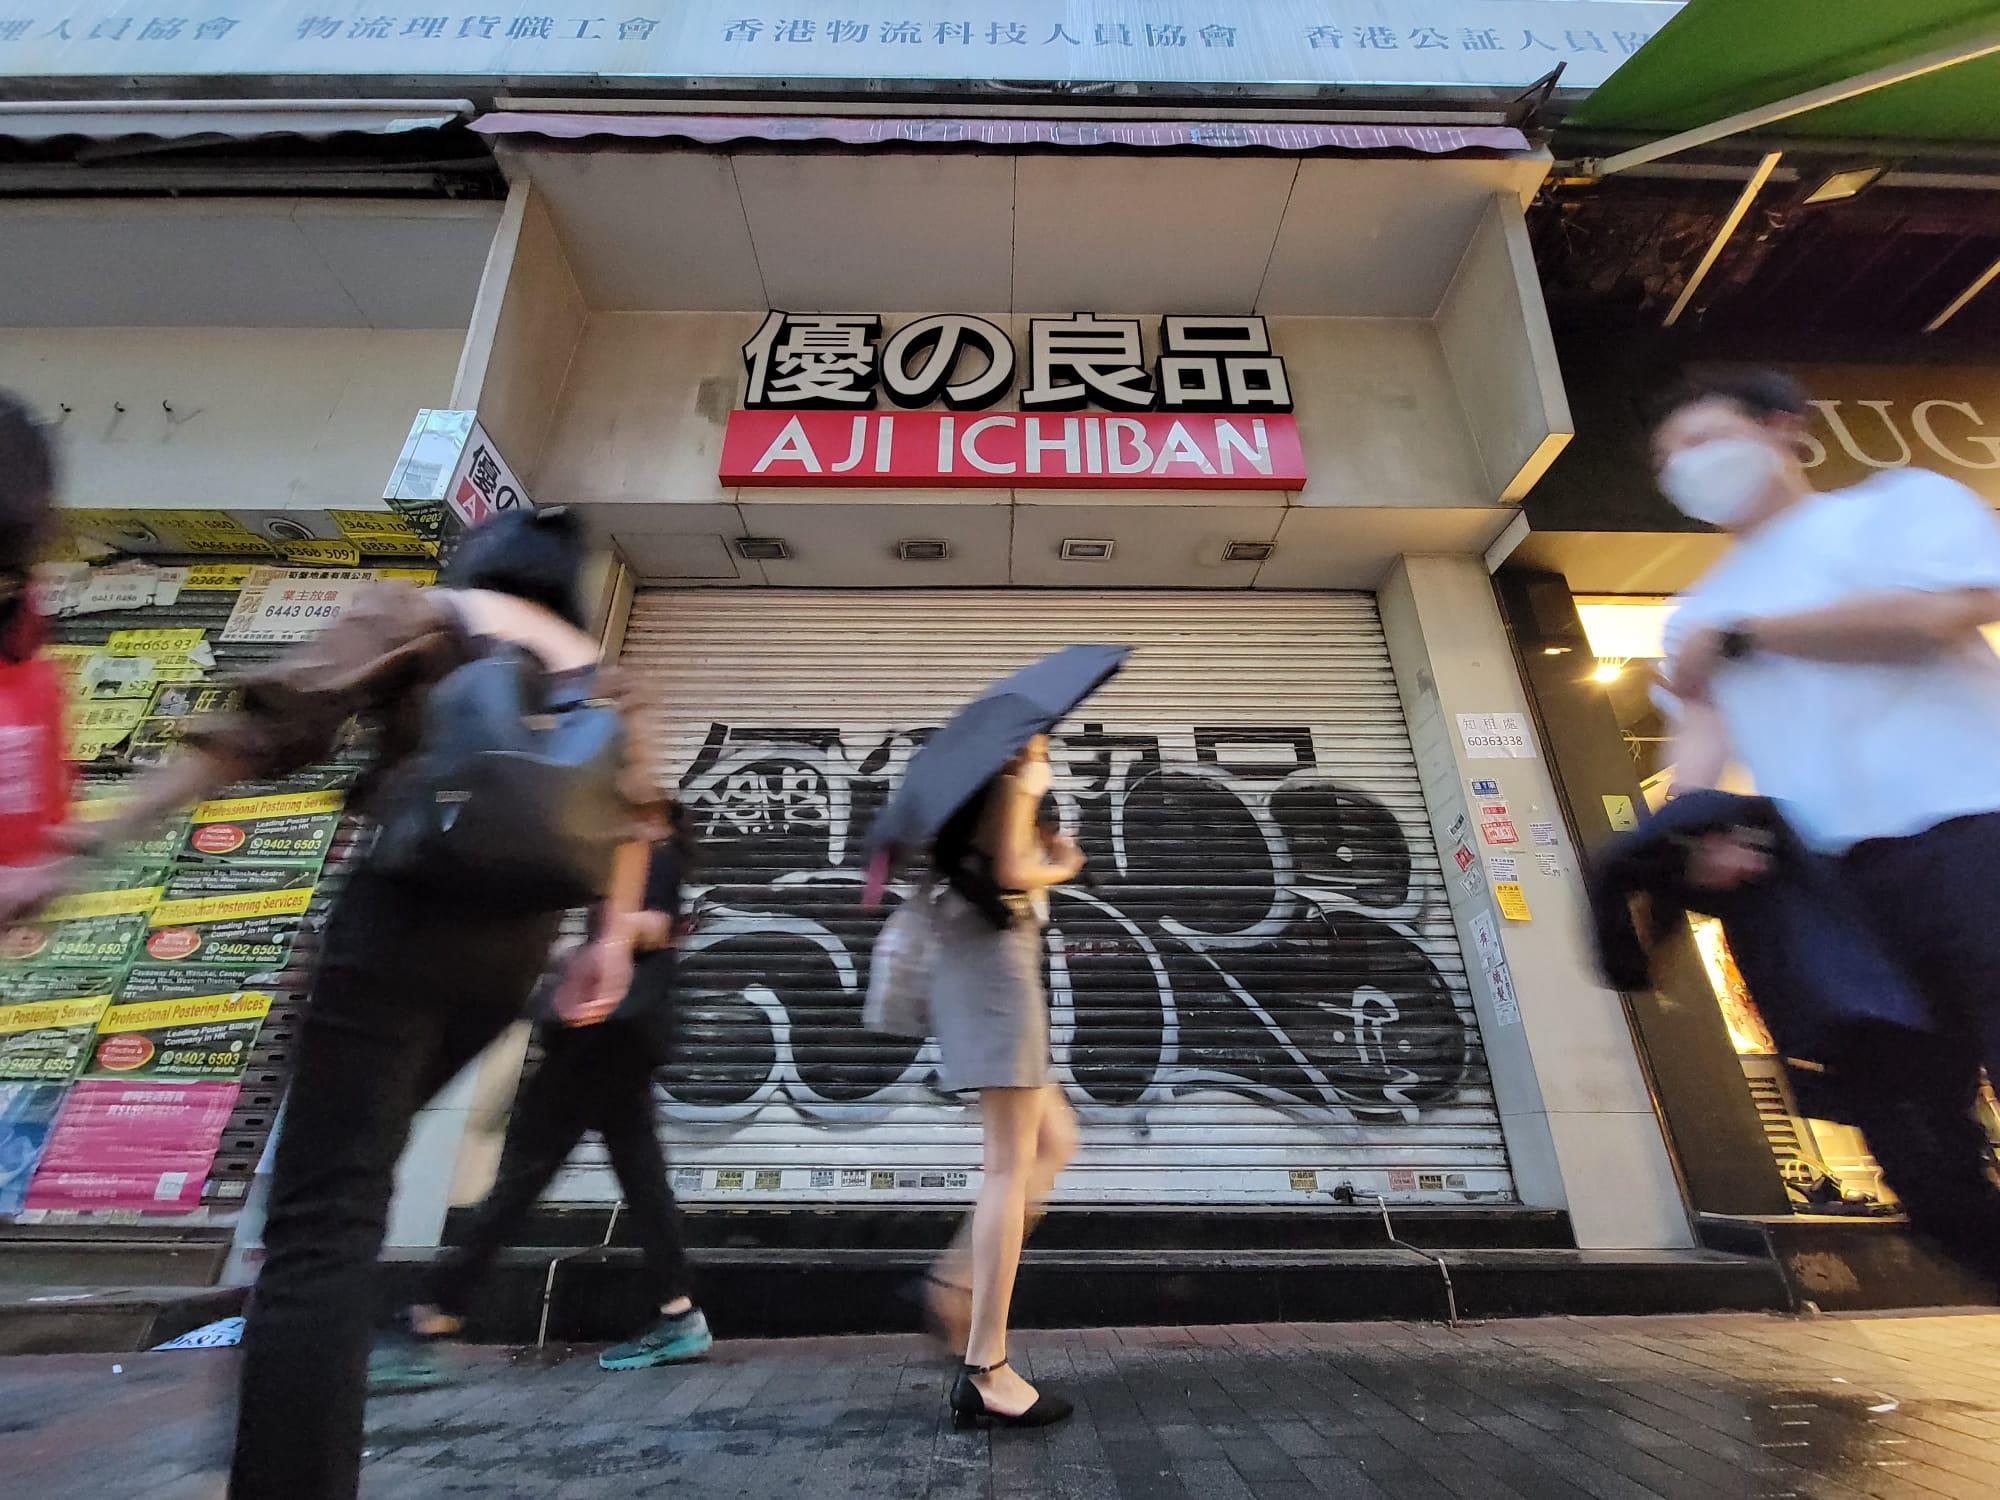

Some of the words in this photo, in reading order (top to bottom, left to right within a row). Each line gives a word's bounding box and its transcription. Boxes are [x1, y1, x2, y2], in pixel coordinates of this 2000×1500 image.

[295, 14, 661, 42] 物流理貨職工會
[723, 18, 1237, 48] 香港物流科技人員協會
[742, 309, 1293, 412] 優の良品
[751, 414, 893, 474] AJI
[937, 415, 1273, 475] ICHIBAN
[345, 520, 384, 532] 9463
[361, 541, 398, 552] 6859
[284, 546, 321, 558] 9368
[327, 548, 357, 561] 5091
[265, 605, 300, 618] 6443
[305, 606, 341, 618] 0486
[1467, 735, 1523, 746] 60363338
[202, 802, 259, 818] Professional
[261, 799, 302, 813] Postering
[257, 819, 288, 828] Leading
[255, 826, 290, 835] Company
[262, 839, 292, 850] 9402
[294, 838, 322, 850] 6503
[217, 899, 260, 914] Postering
[263, 894, 304, 910] Services
[218, 944, 250, 955] 9402
[252, 944, 283, 955] 6503
[13, 1007, 59, 1025] Postering
[61, 1004, 103, 1017] Services
[108, 1009, 171, 1026] Professional
[172, 1004, 219, 1019] Postering
[222, 997, 264, 1013] Services
[167, 1029, 200, 1038] Leading
[201, 1026, 227, 1034] Poster
[164, 1036, 203, 1046] Company
[172, 1053, 206, 1065] 9402
[207, 1053, 240, 1065] 6503
